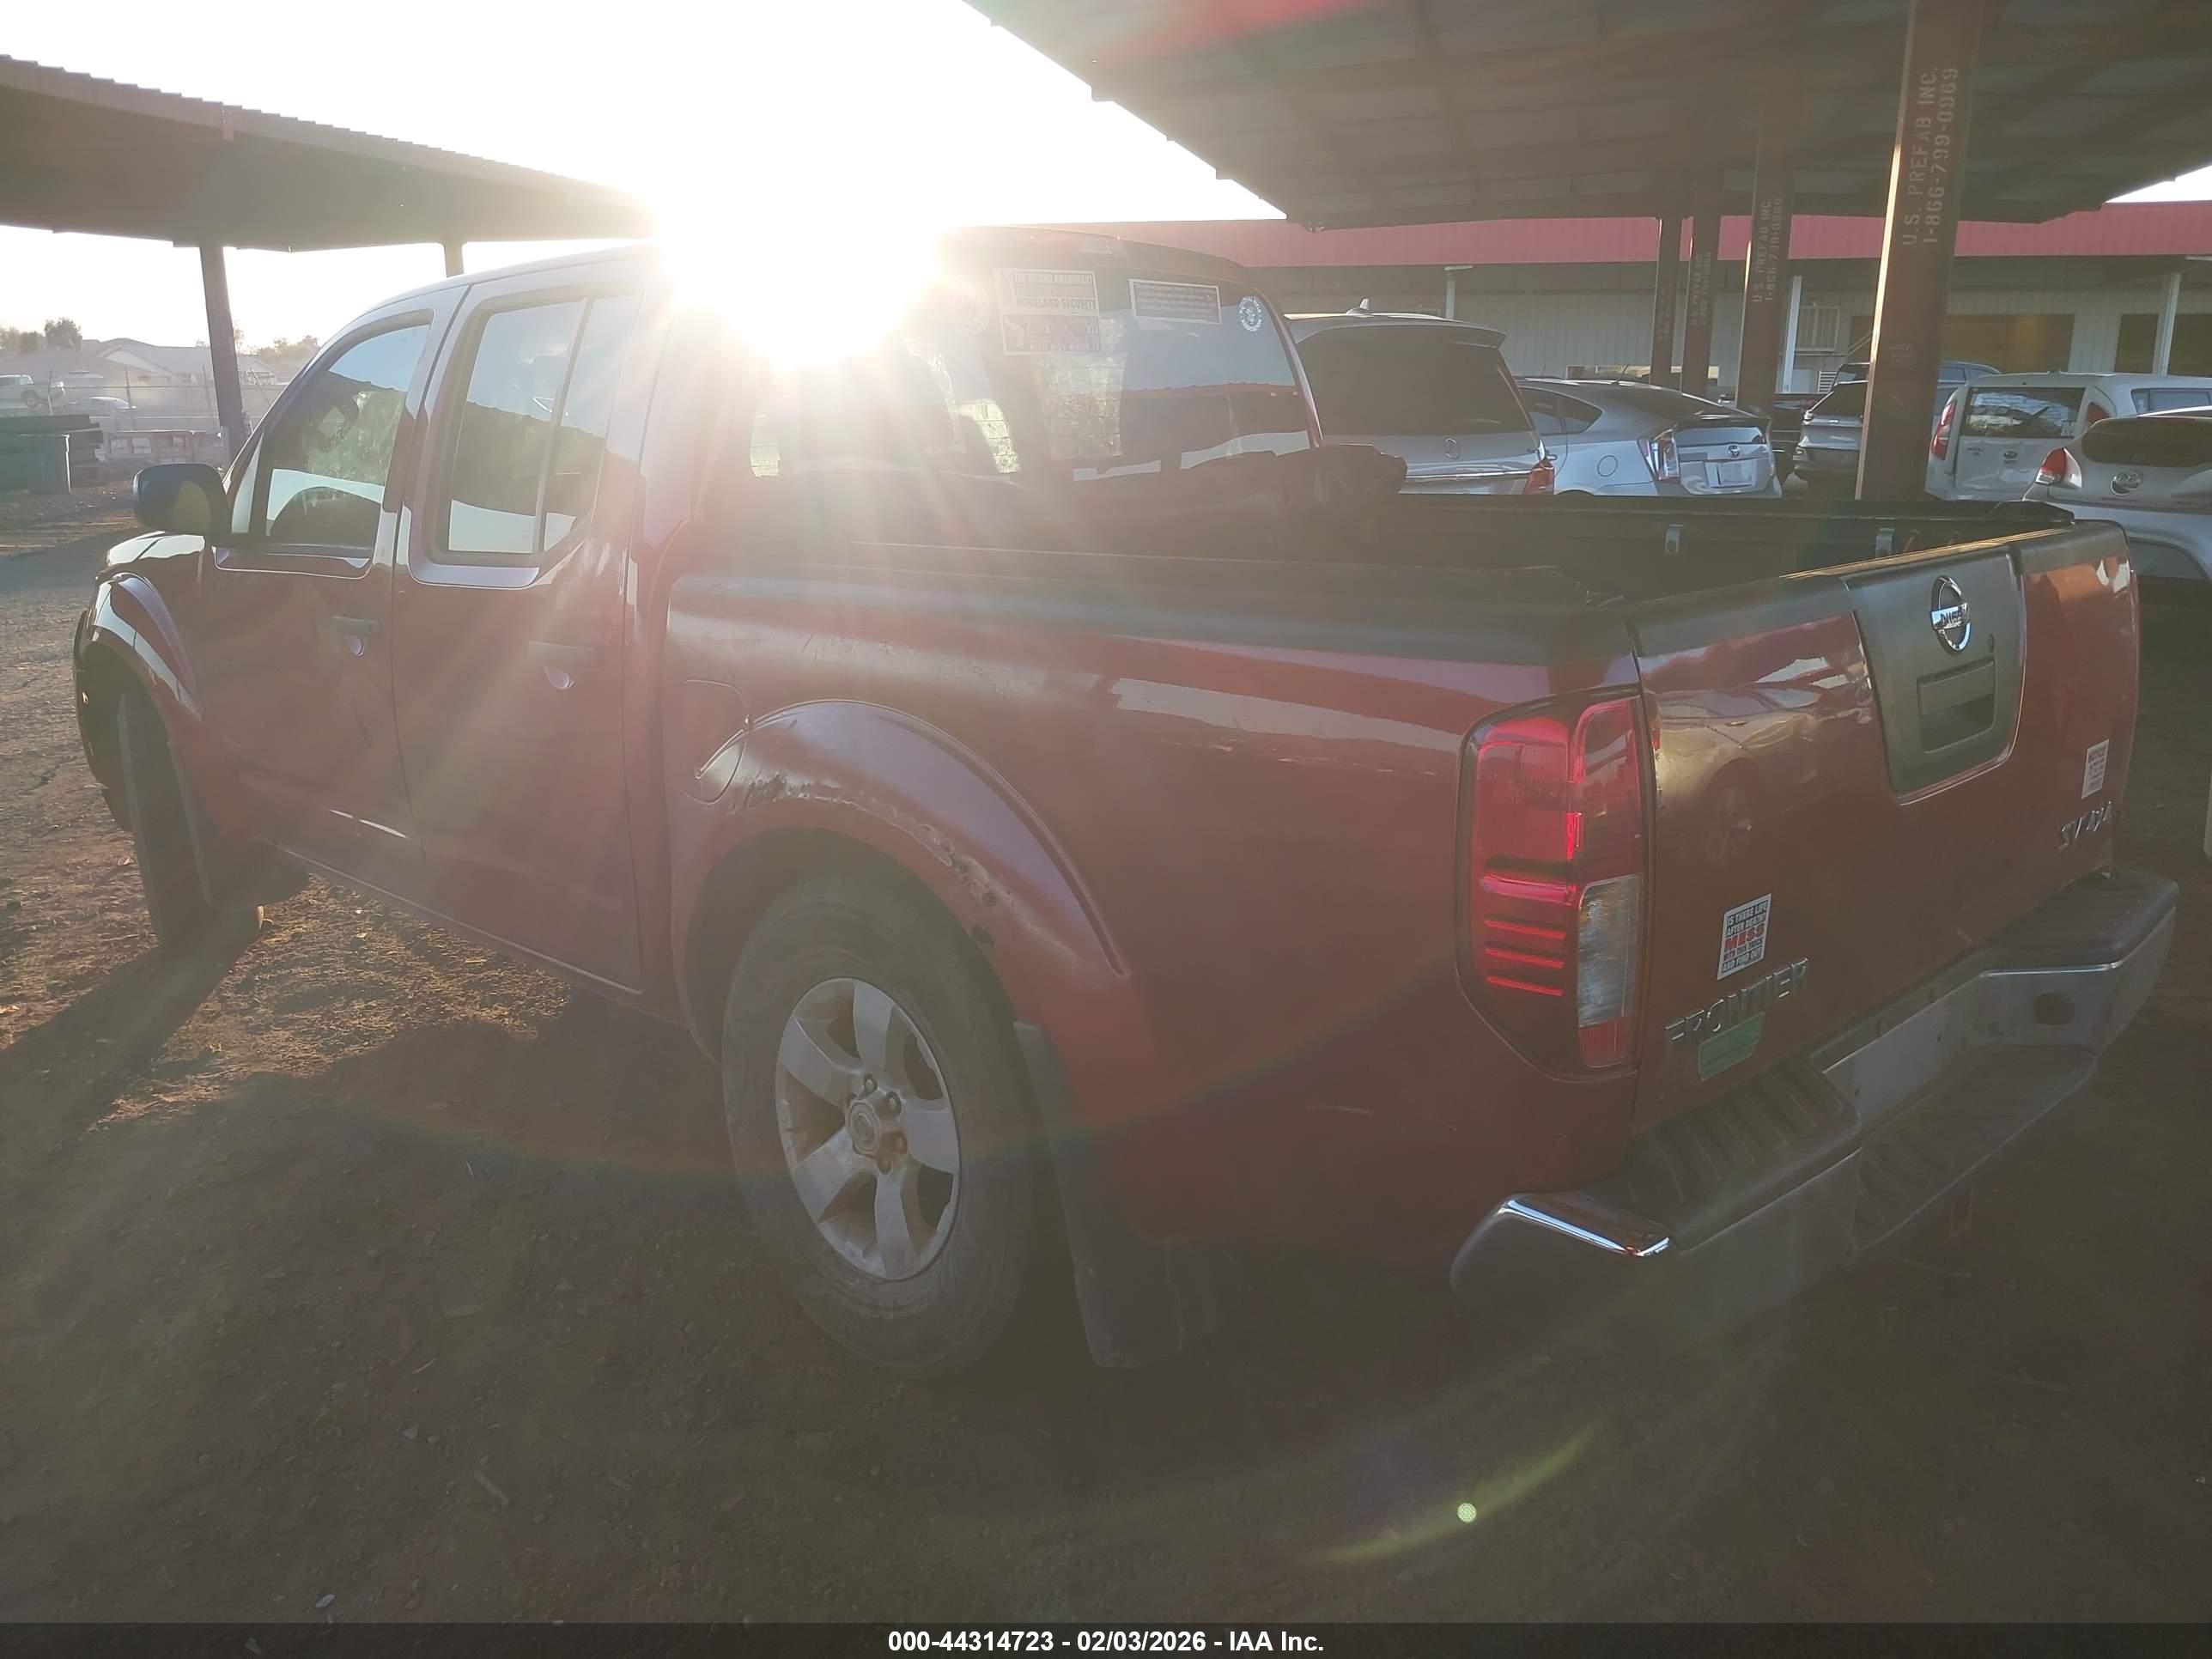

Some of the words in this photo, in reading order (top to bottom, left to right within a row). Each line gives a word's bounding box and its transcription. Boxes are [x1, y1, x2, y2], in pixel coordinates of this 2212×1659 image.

[1917, 67, 1938, 106] INC.
[1907, 117, 1932, 196] PREFAB
[1923, 68, 1959, 244] 1-866-799-0969
[1902, 208, 1922, 246] U.S.
[1725, 921, 1744, 936] AFTER
[1726, 916, 1735, 927] IS
[1735, 906, 1754, 923] THERE
[1754, 900, 1768, 915] LIFE
[1723, 923, 1765, 952] MESS
